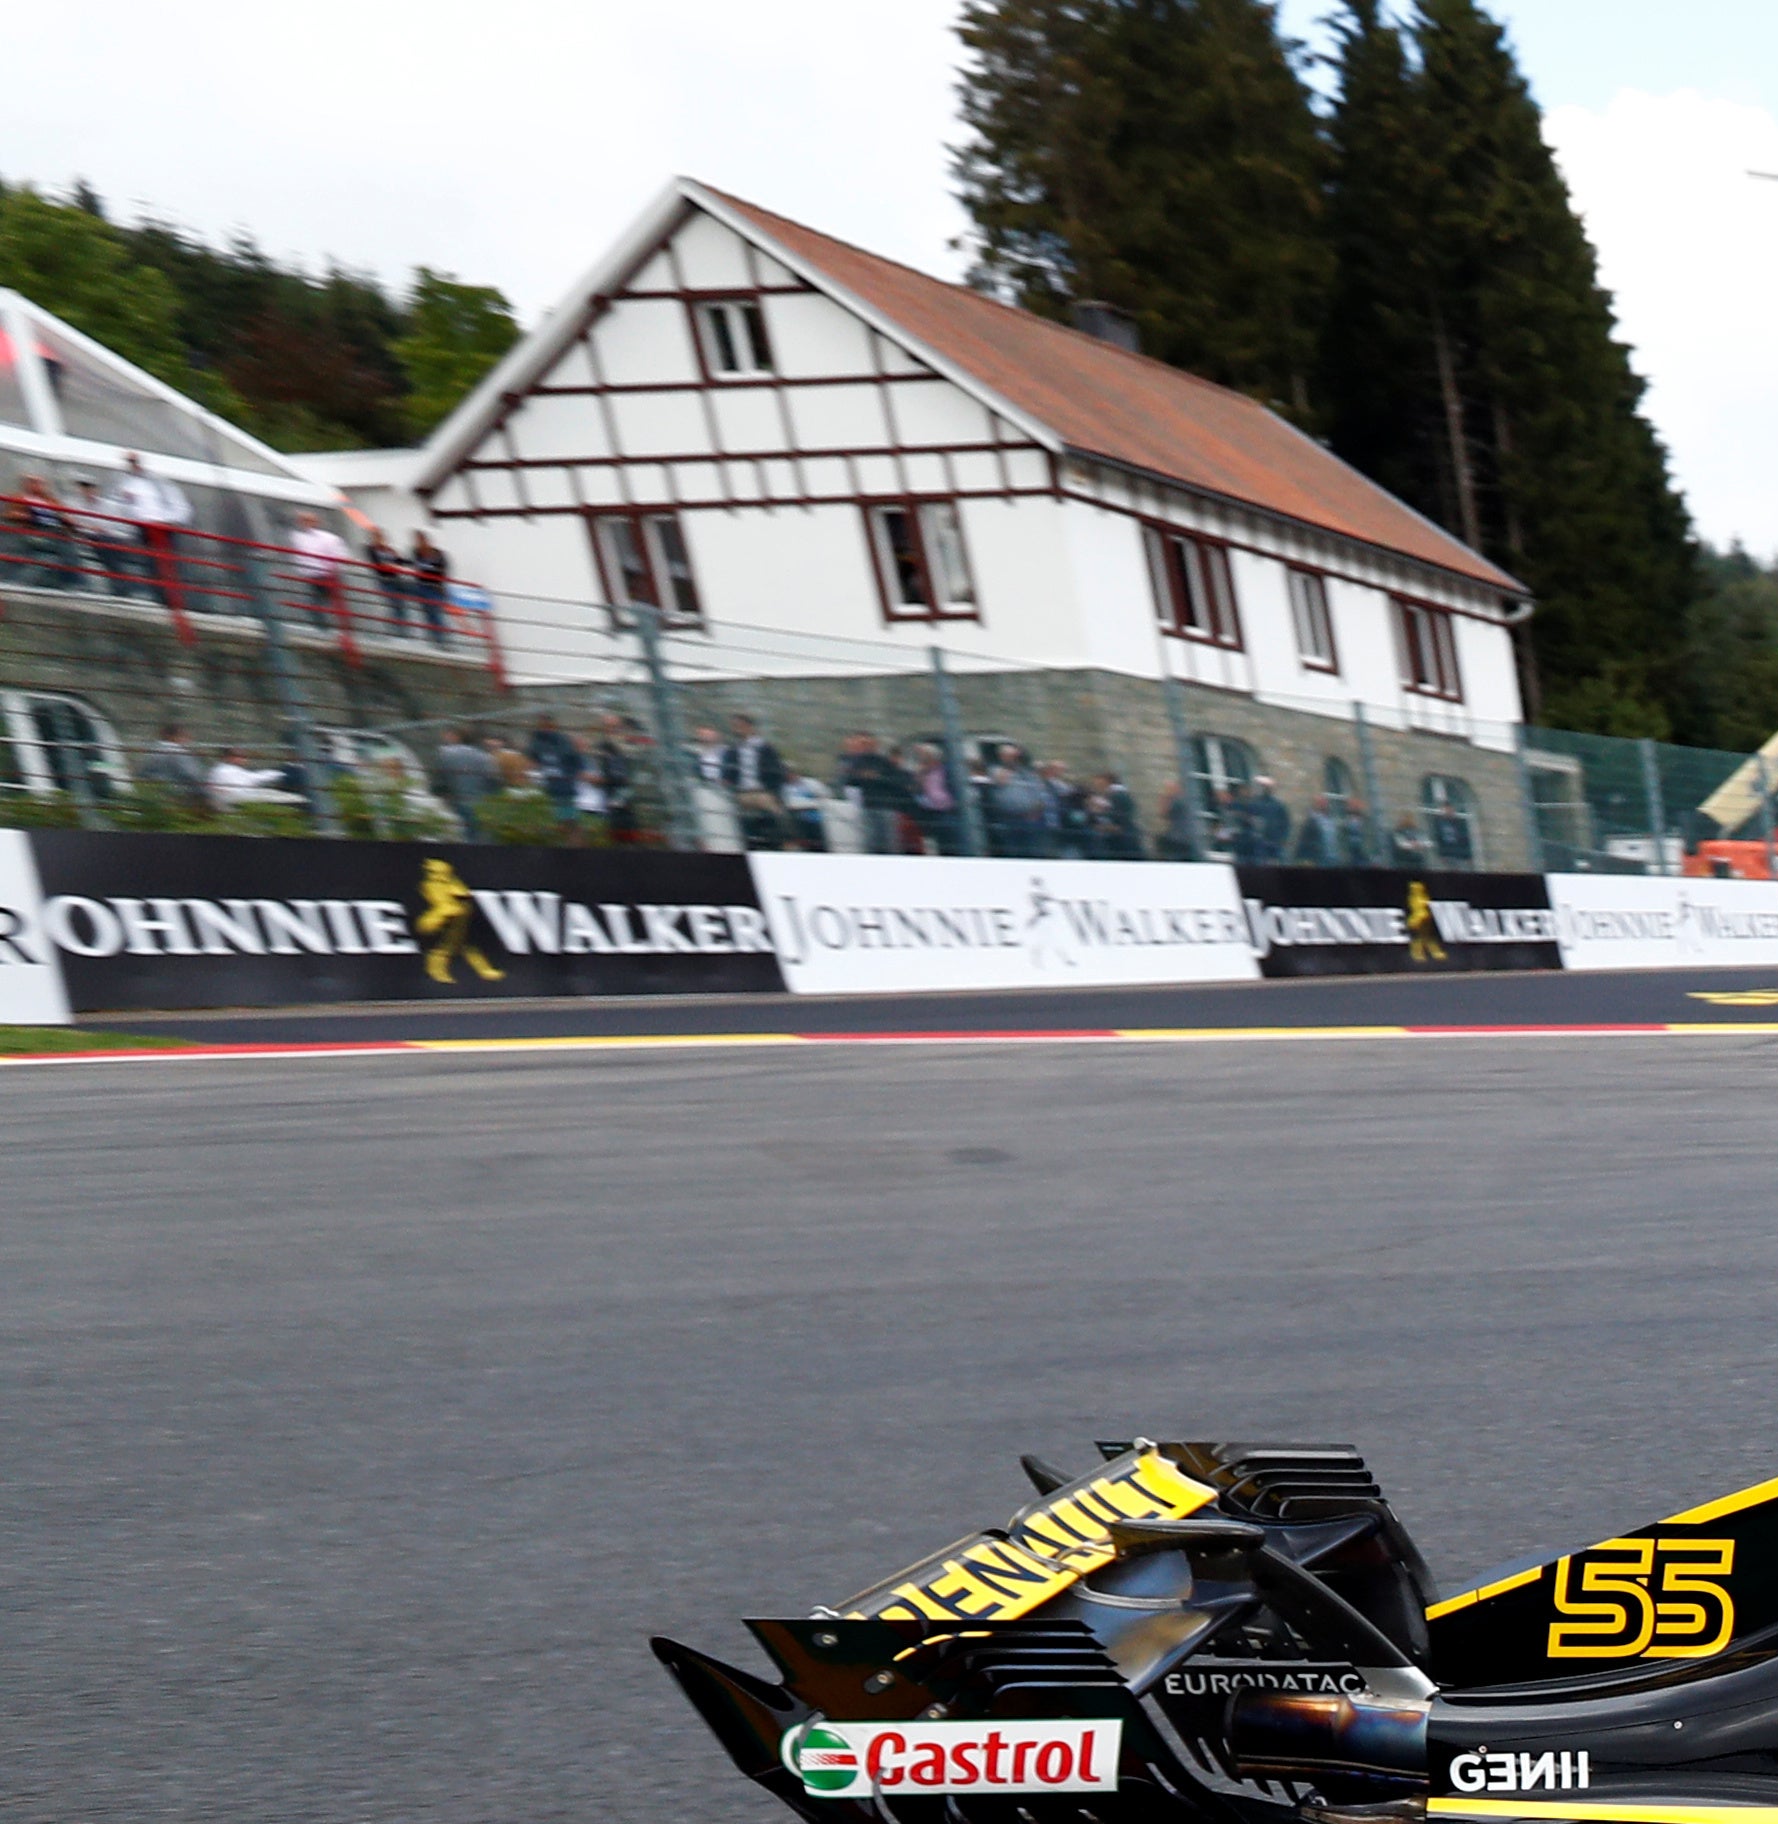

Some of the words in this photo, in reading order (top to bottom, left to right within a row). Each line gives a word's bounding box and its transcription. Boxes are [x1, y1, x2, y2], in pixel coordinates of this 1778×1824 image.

[44, 895, 420, 957] OHNNIE
[470, 889, 777, 954] WALKER
[778, 895, 1016, 964] JOHNNIE
[1060, 898, 1247, 947] WALKER
[1247, 898, 1408, 958] JOHNNIE
[1429, 901, 1559, 944] WALKER
[1547, 1537, 1735, 1659] 55
[865, 1731, 1101, 1786] Castrol
